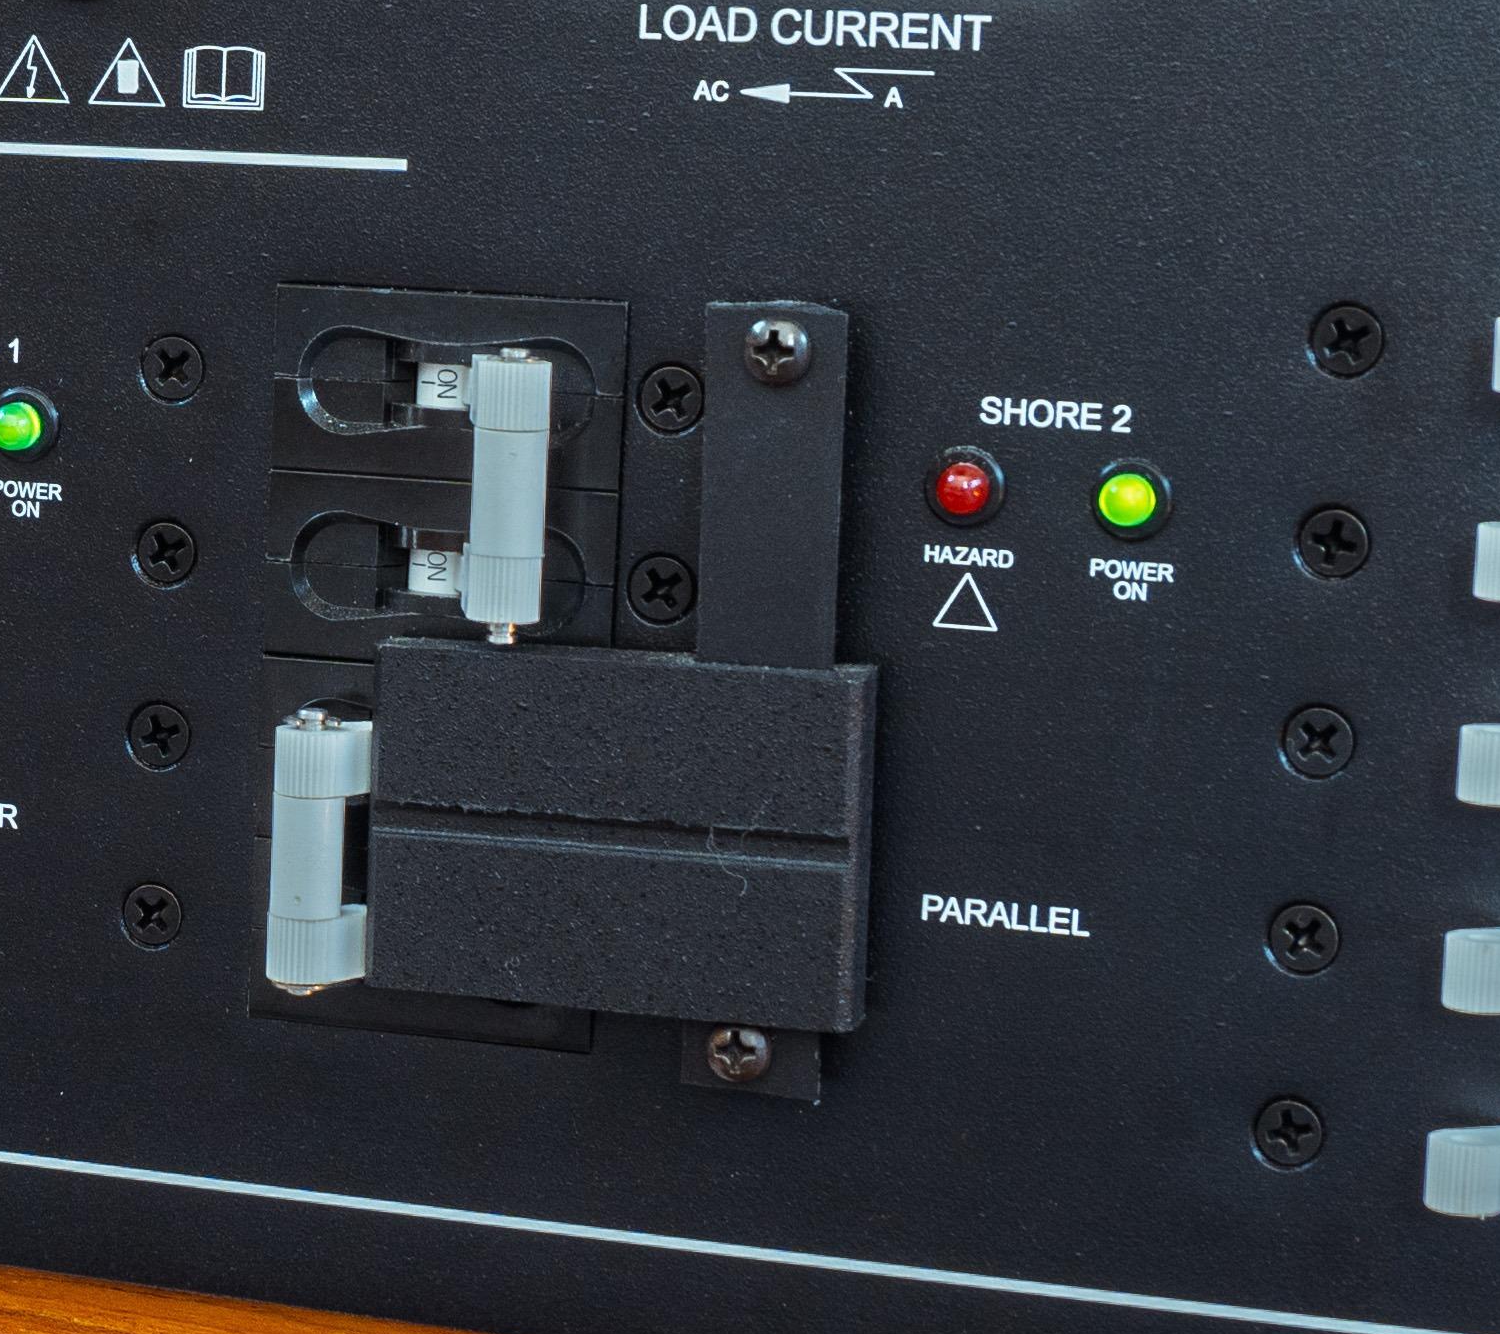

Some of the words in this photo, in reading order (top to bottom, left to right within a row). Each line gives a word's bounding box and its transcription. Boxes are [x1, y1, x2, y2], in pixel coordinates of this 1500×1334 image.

[638, 3, 758, 43] LOAD
[770, 7, 993, 52] CURRENT
[692, 79, 730, 103] AC
[883, 86, 904, 109] A
[8, 337, 20, 364] 1
[437, 368, 458, 399] ON
[979, 395, 1103, 432] SHORE
[1110, 404, 1132, 434] 2
[11, 499, 40, 519] ON
[427, 550, 448, 582] ON
[923, 544, 1015, 569] HAZARD
[1089, 557, 1174, 583] POWER
[1112, 580, 1148, 602] ON
[921, 893, 1091, 938] PARALLEL
